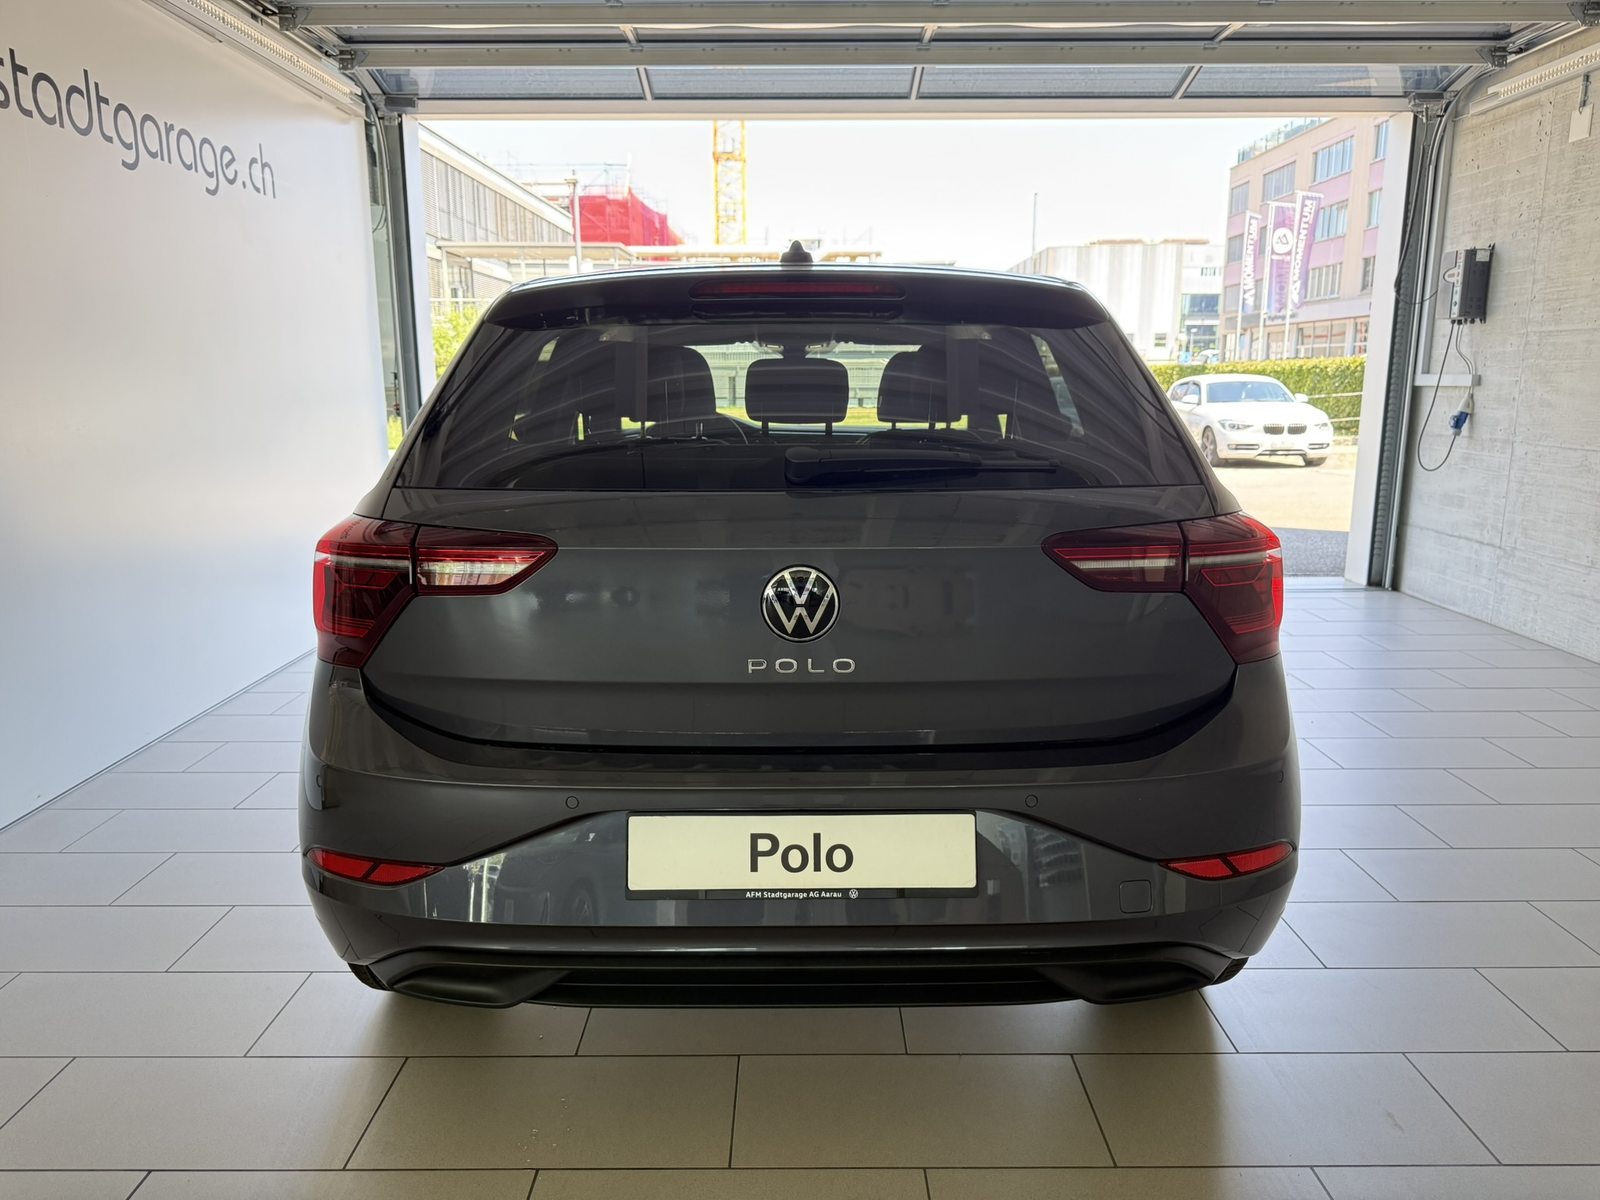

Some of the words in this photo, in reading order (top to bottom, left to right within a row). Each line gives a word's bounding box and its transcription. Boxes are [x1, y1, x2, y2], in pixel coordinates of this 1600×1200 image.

[1243, 218, 1257, 289] MOMENTUM
[1293, 199, 1314, 282] MOMENTUM
[748, 658, 856, 673] POLO
[750, 832, 854, 873] Polo
[763, 891, 808, 899] Stadtgarage
